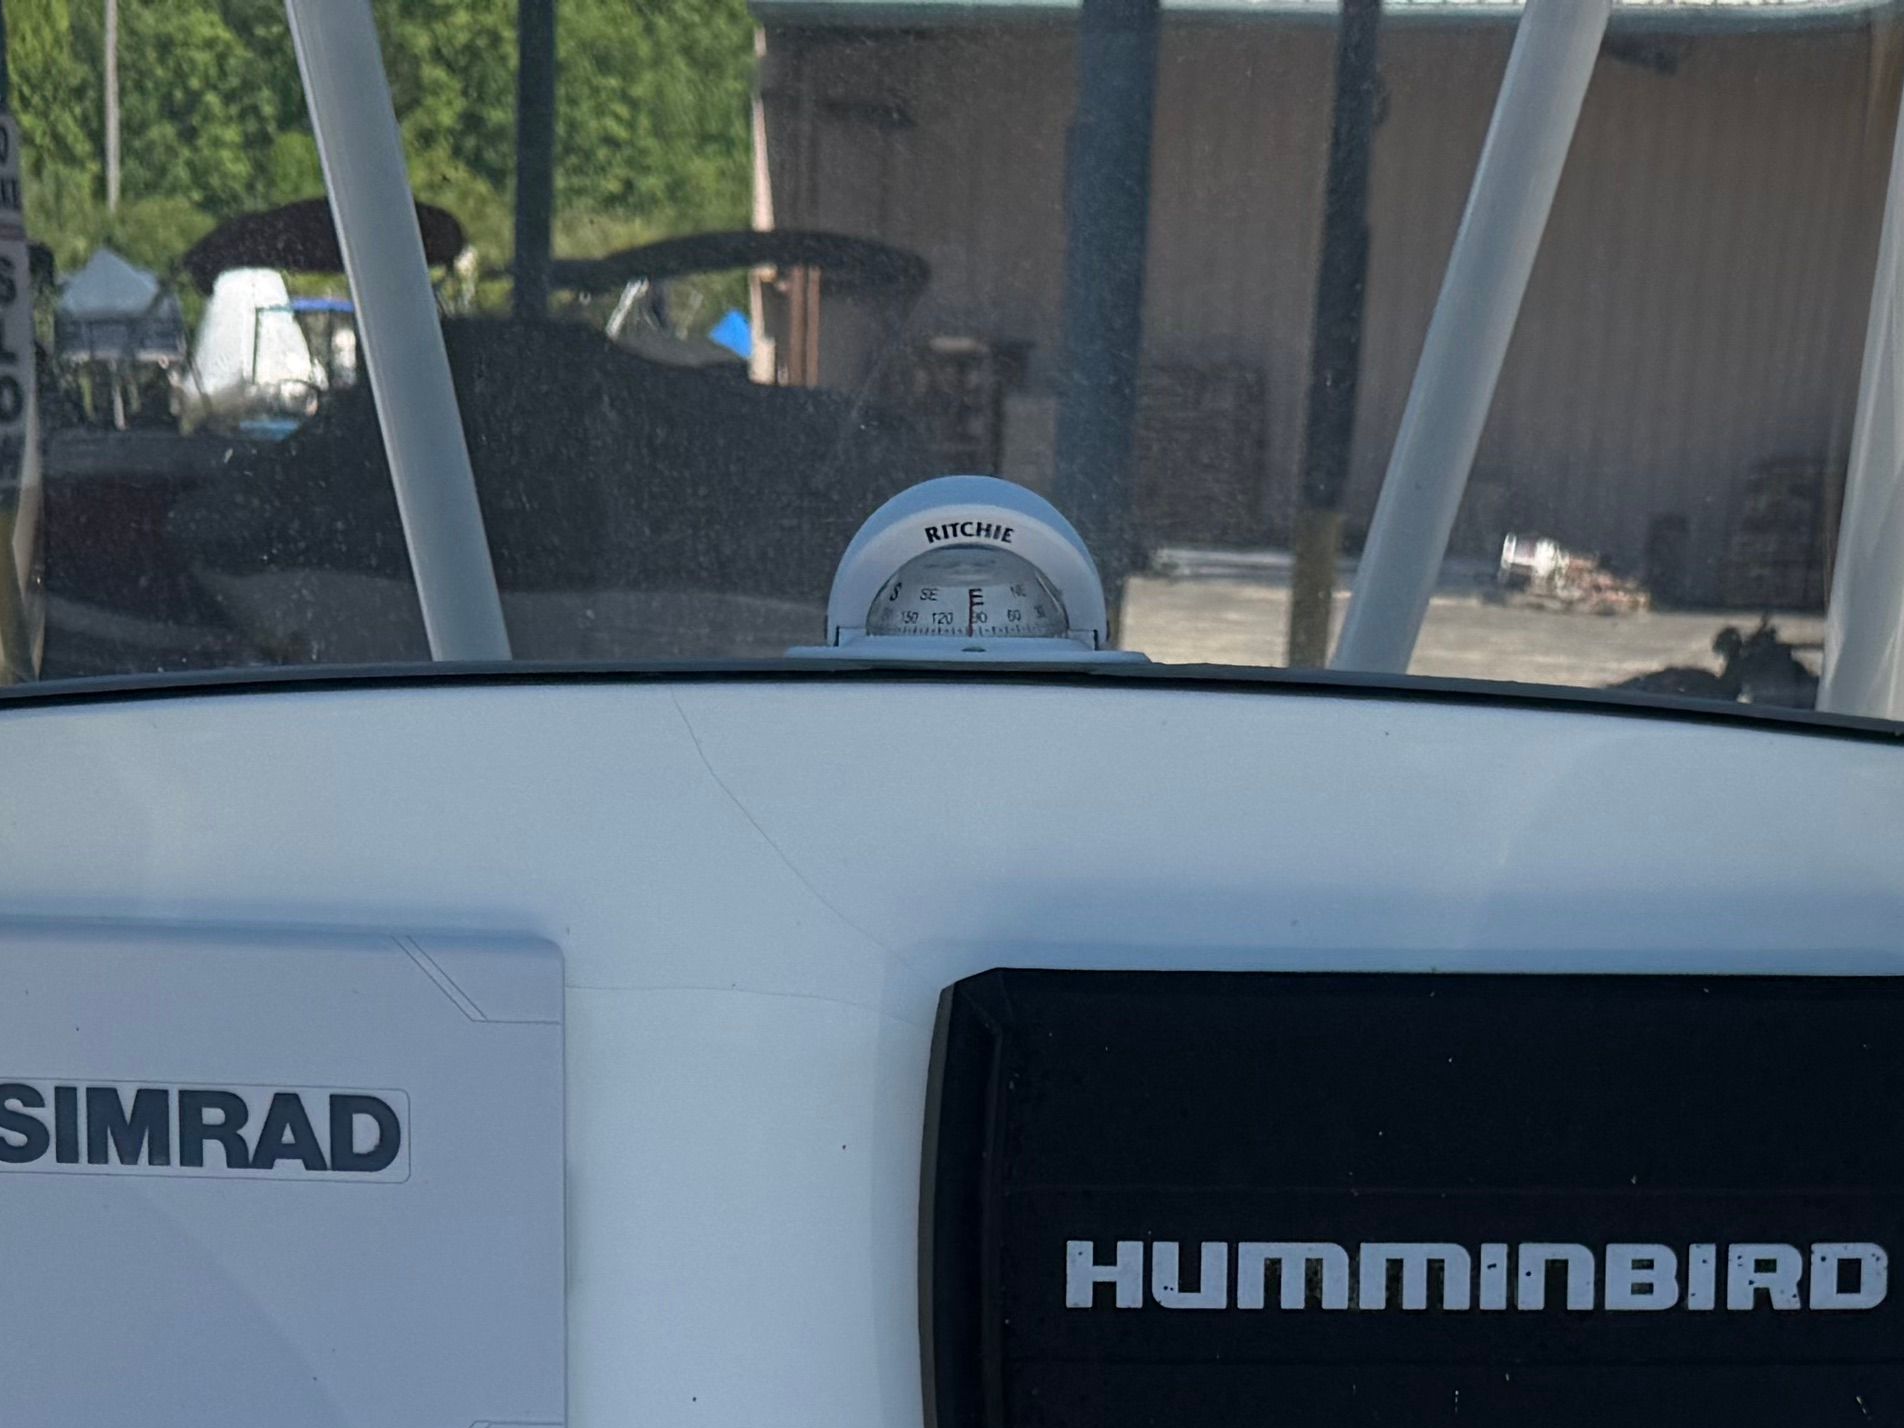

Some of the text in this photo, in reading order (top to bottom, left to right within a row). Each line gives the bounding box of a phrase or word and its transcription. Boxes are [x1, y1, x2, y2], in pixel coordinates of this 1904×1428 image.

[925, 522, 1015, 544] RITCHIE
[920, 588, 939, 601] SE
[932, 611, 953, 625] 120
[1064, 1240, 1890, 1311] HUMMINBIRD
